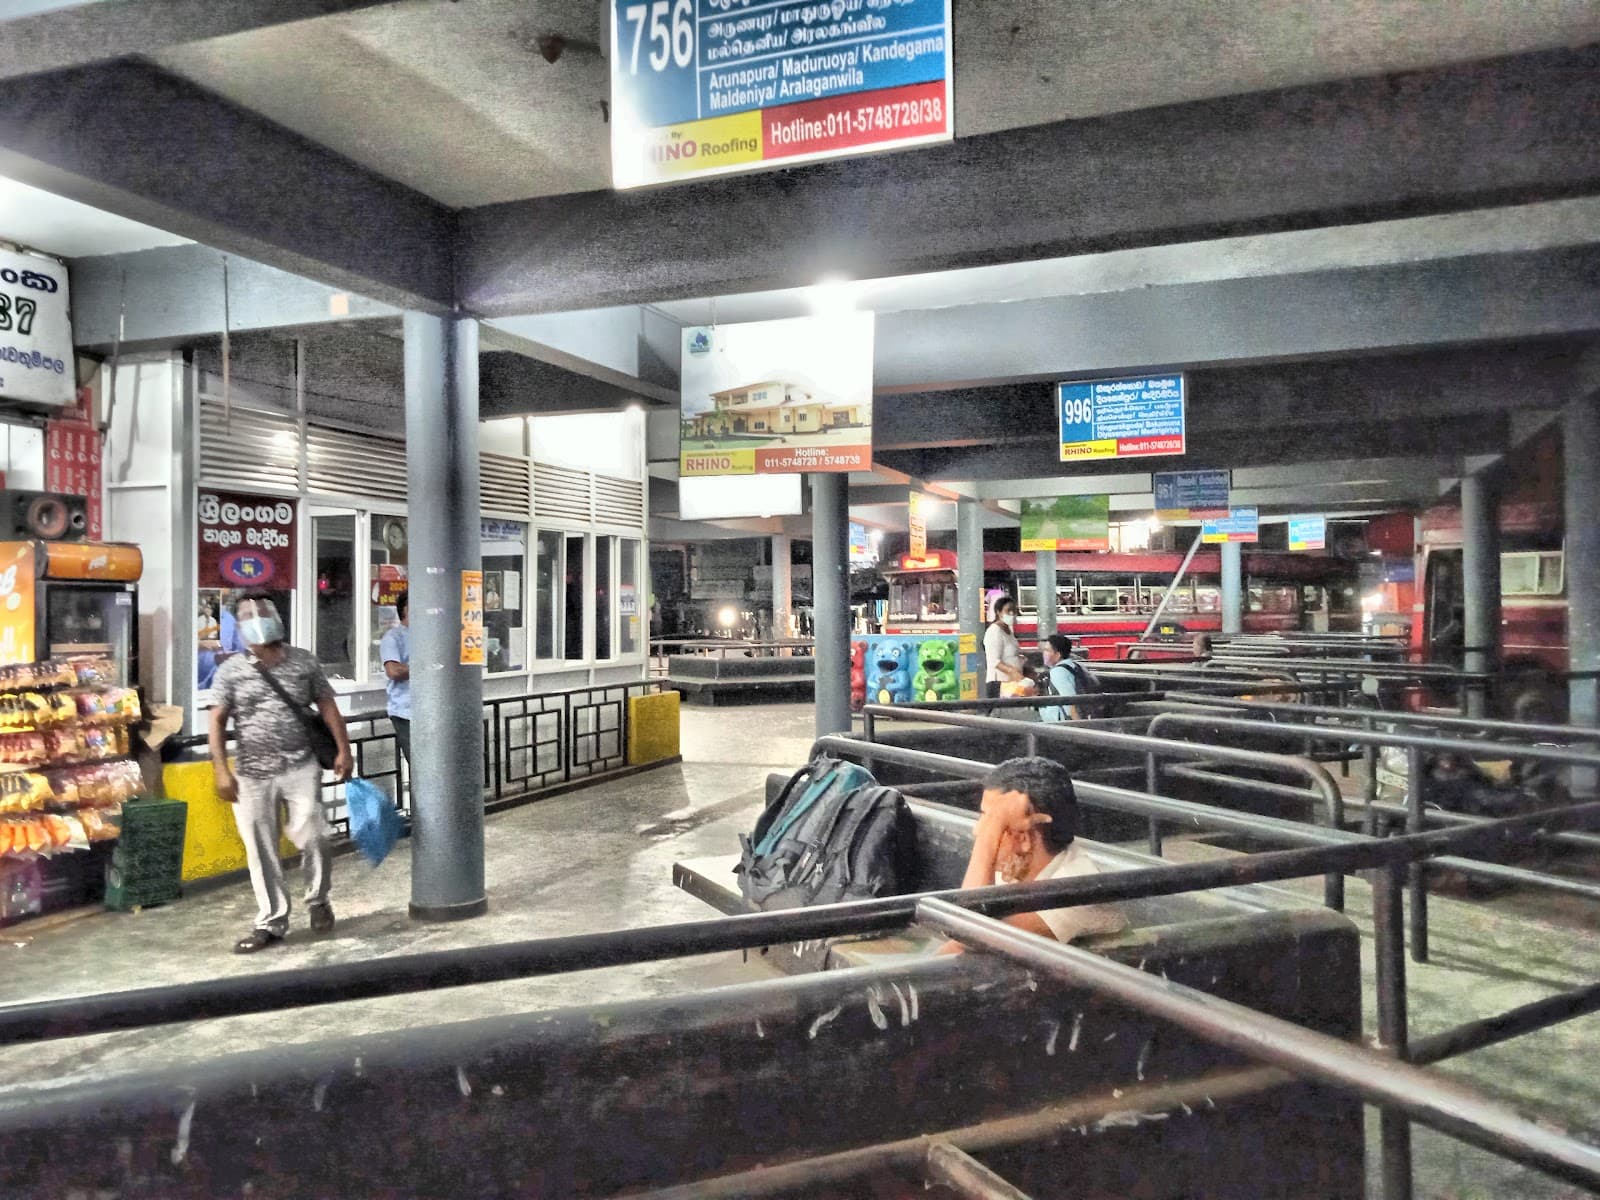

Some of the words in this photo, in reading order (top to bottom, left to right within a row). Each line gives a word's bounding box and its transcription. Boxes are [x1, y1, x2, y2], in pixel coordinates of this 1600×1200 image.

[627, 1, 692, 76] 756
[709, 61, 779, 90] Arunapura/
[782, 46, 860, 75] Maduruoya/
[862, 36, 944, 63] Kandegama
[709, 84, 779, 110] Maldeniya/
[780, 68, 864, 98] Aralaganwila
[771, 98, 943, 146] Hotline:011-5748728/38
[701, 137, 758, 157] Roofing
[1064, 399, 1092, 424] 996
[795, 448, 828, 457] Hotline:
[1064, 447, 1092, 456] RHINO
[686, 458, 730, 471] RHINO
